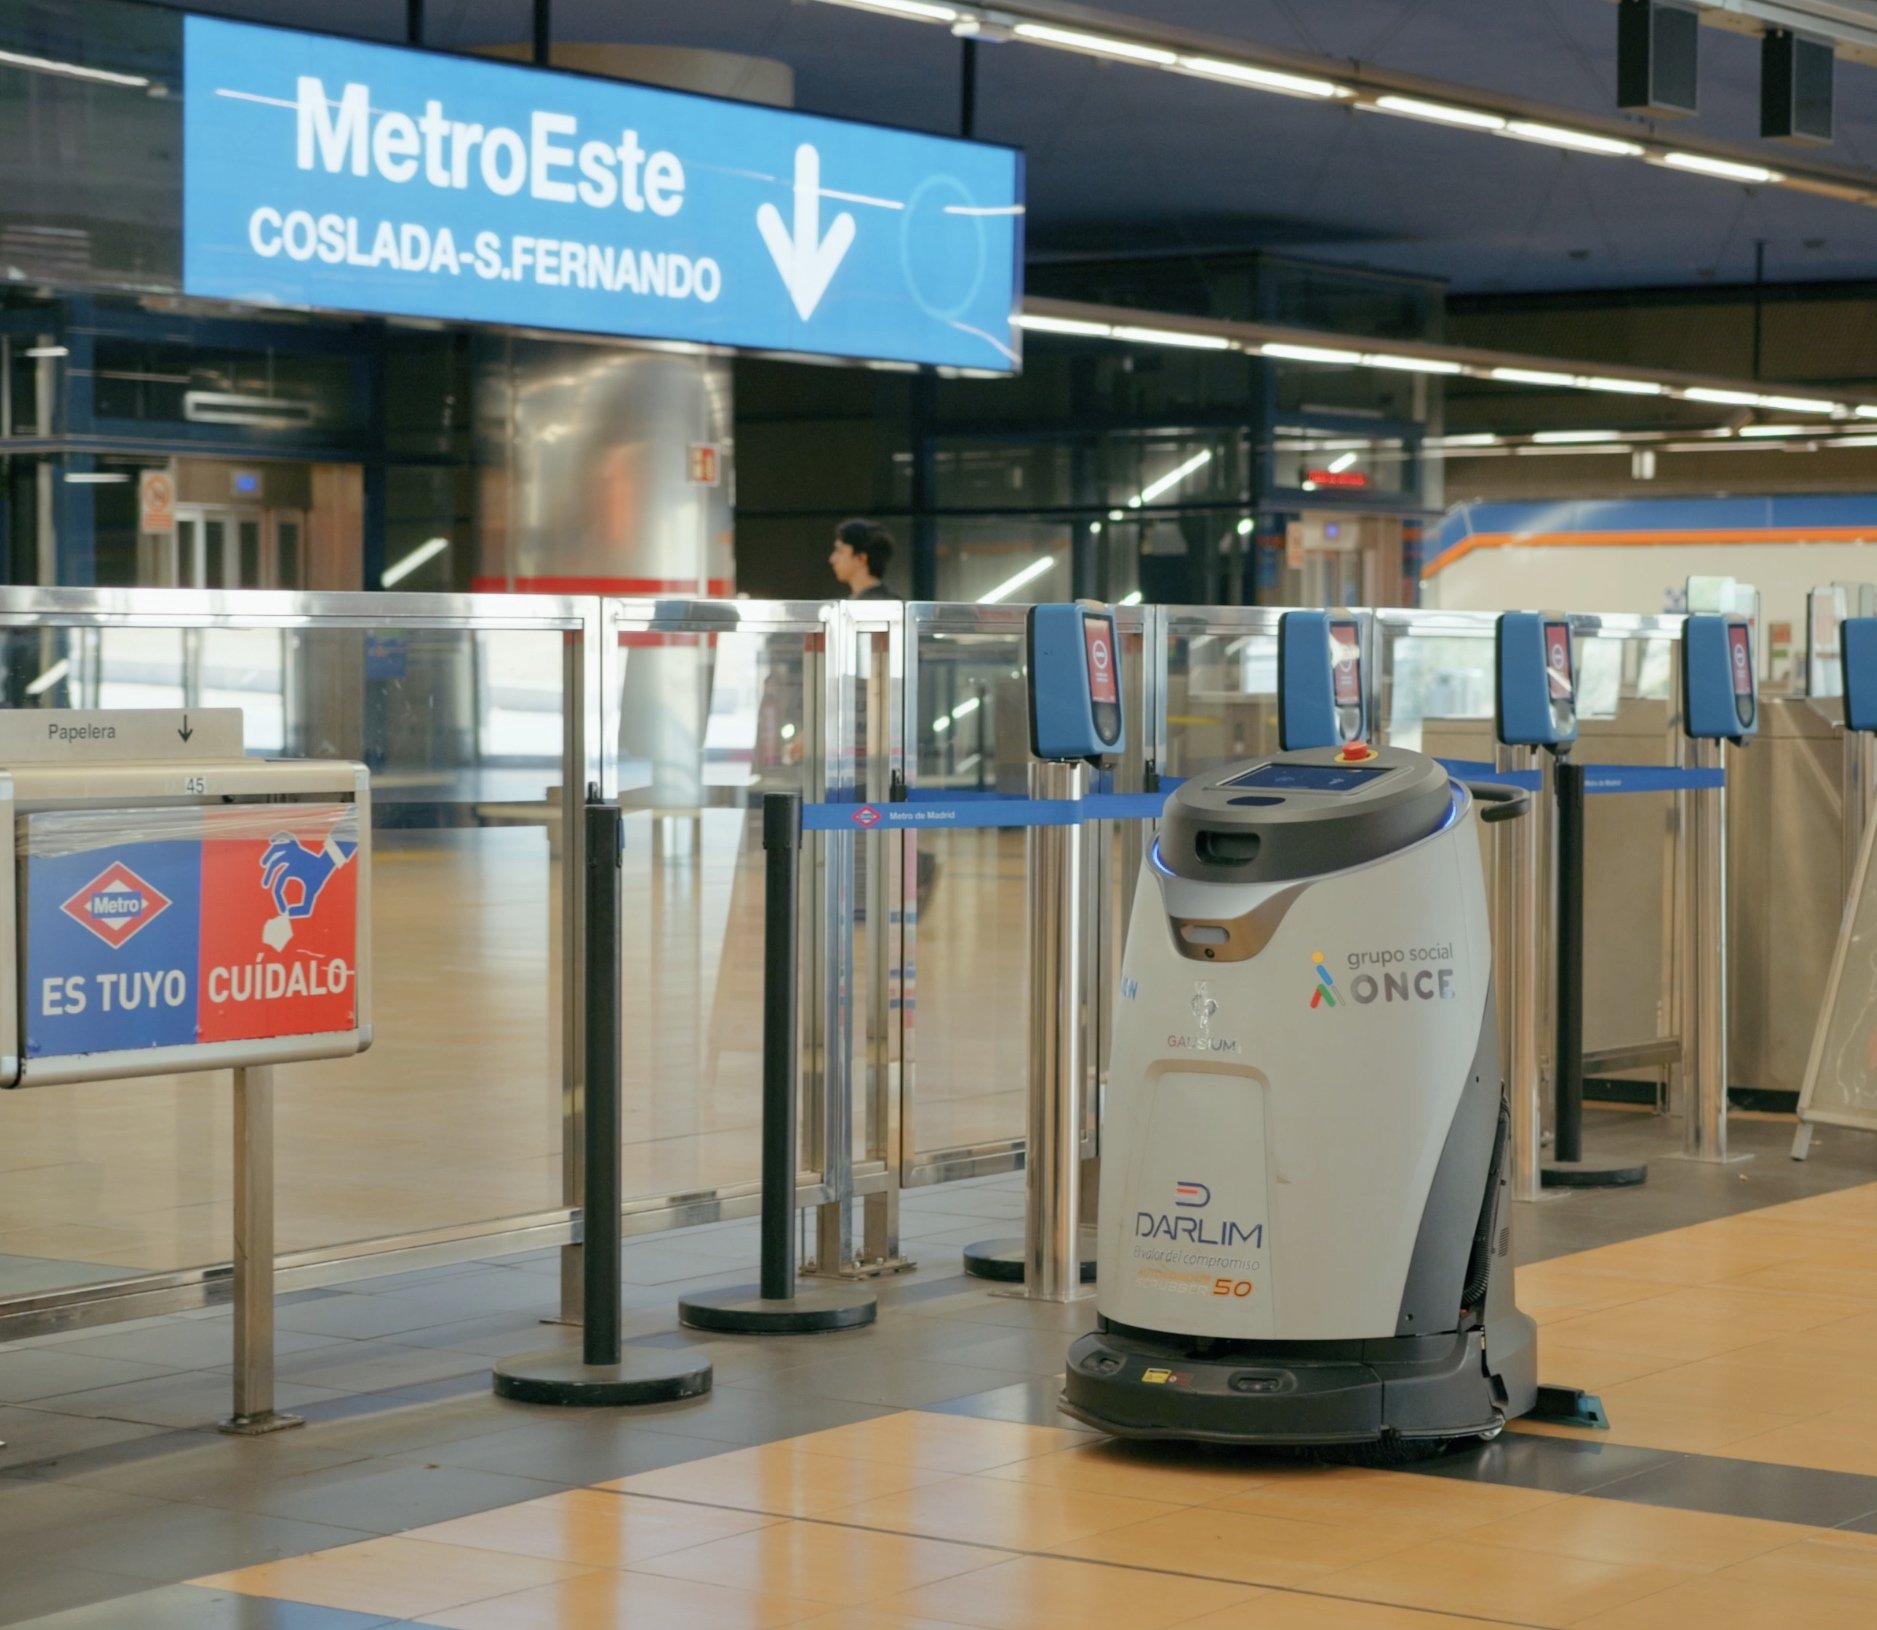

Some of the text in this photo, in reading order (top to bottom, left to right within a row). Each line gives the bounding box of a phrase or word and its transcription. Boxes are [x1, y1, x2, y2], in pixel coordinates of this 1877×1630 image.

[297, 76, 685, 217] MetroEste
[248, 206, 721, 303] COSLADA-S.FERNANDO
[48, 724, 116, 743] Papelera
[186, 777, 205, 794] 45
[889, 811, 956, 820] Metro de Madrid
[93, 897, 140, 914] Metro
[1347, 943, 1453, 970] grupo social
[42, 953, 347, 1016] ES TUYO CUÍDALO
[1351, 968, 1455, 1004] ONCE
[1135, 1212, 1263, 1249] DARLIM
[1165, 1250, 1182, 1263] del
[1183, 1252, 1260, 1271] compromiso
[1213, 1278, 1253, 1298] 50
